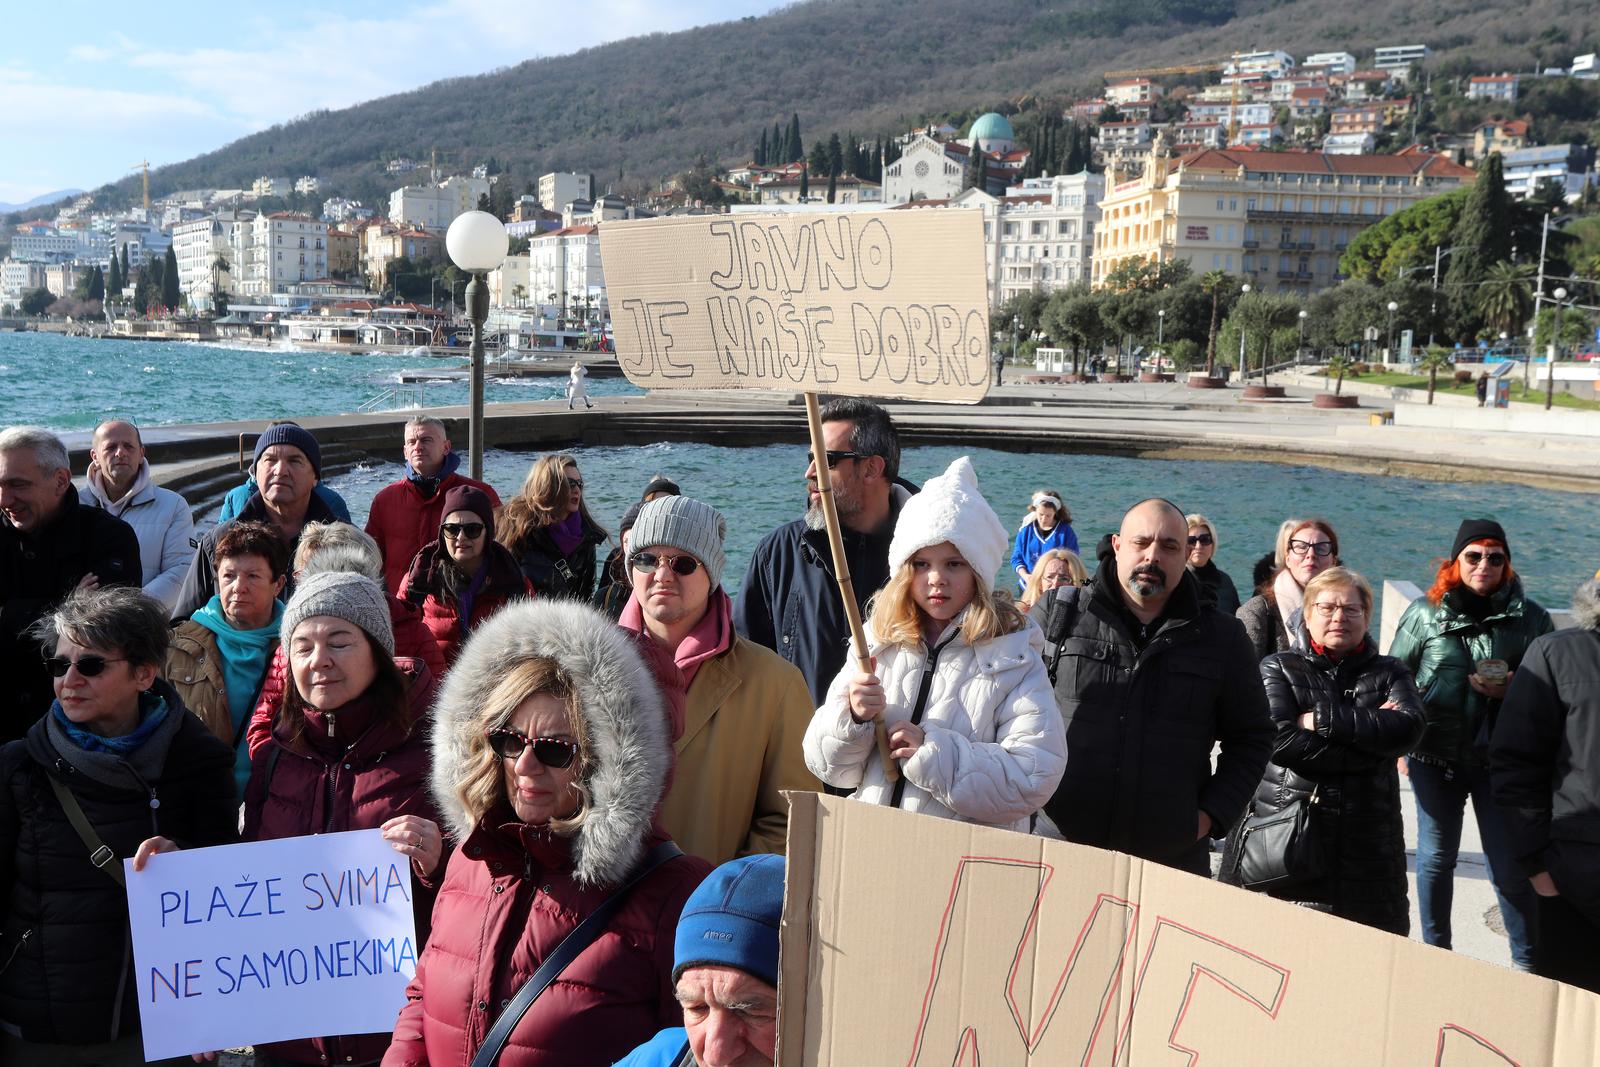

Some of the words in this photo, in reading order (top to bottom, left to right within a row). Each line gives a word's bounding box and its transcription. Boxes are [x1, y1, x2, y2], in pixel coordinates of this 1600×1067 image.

[710, 216, 893, 293] JAVNO
[622, 298, 695, 378] JE
[706, 290, 840, 384] NAŠE
[852, 302, 990, 386] DOBRO
[160, 873, 286, 928] PLAŽE
[301, 863, 411, 911] SVIMA
[150, 959, 203, 1003] NE
[214, 948, 309, 995] SAMO
[313, 936, 417, 981] NEKIMA
